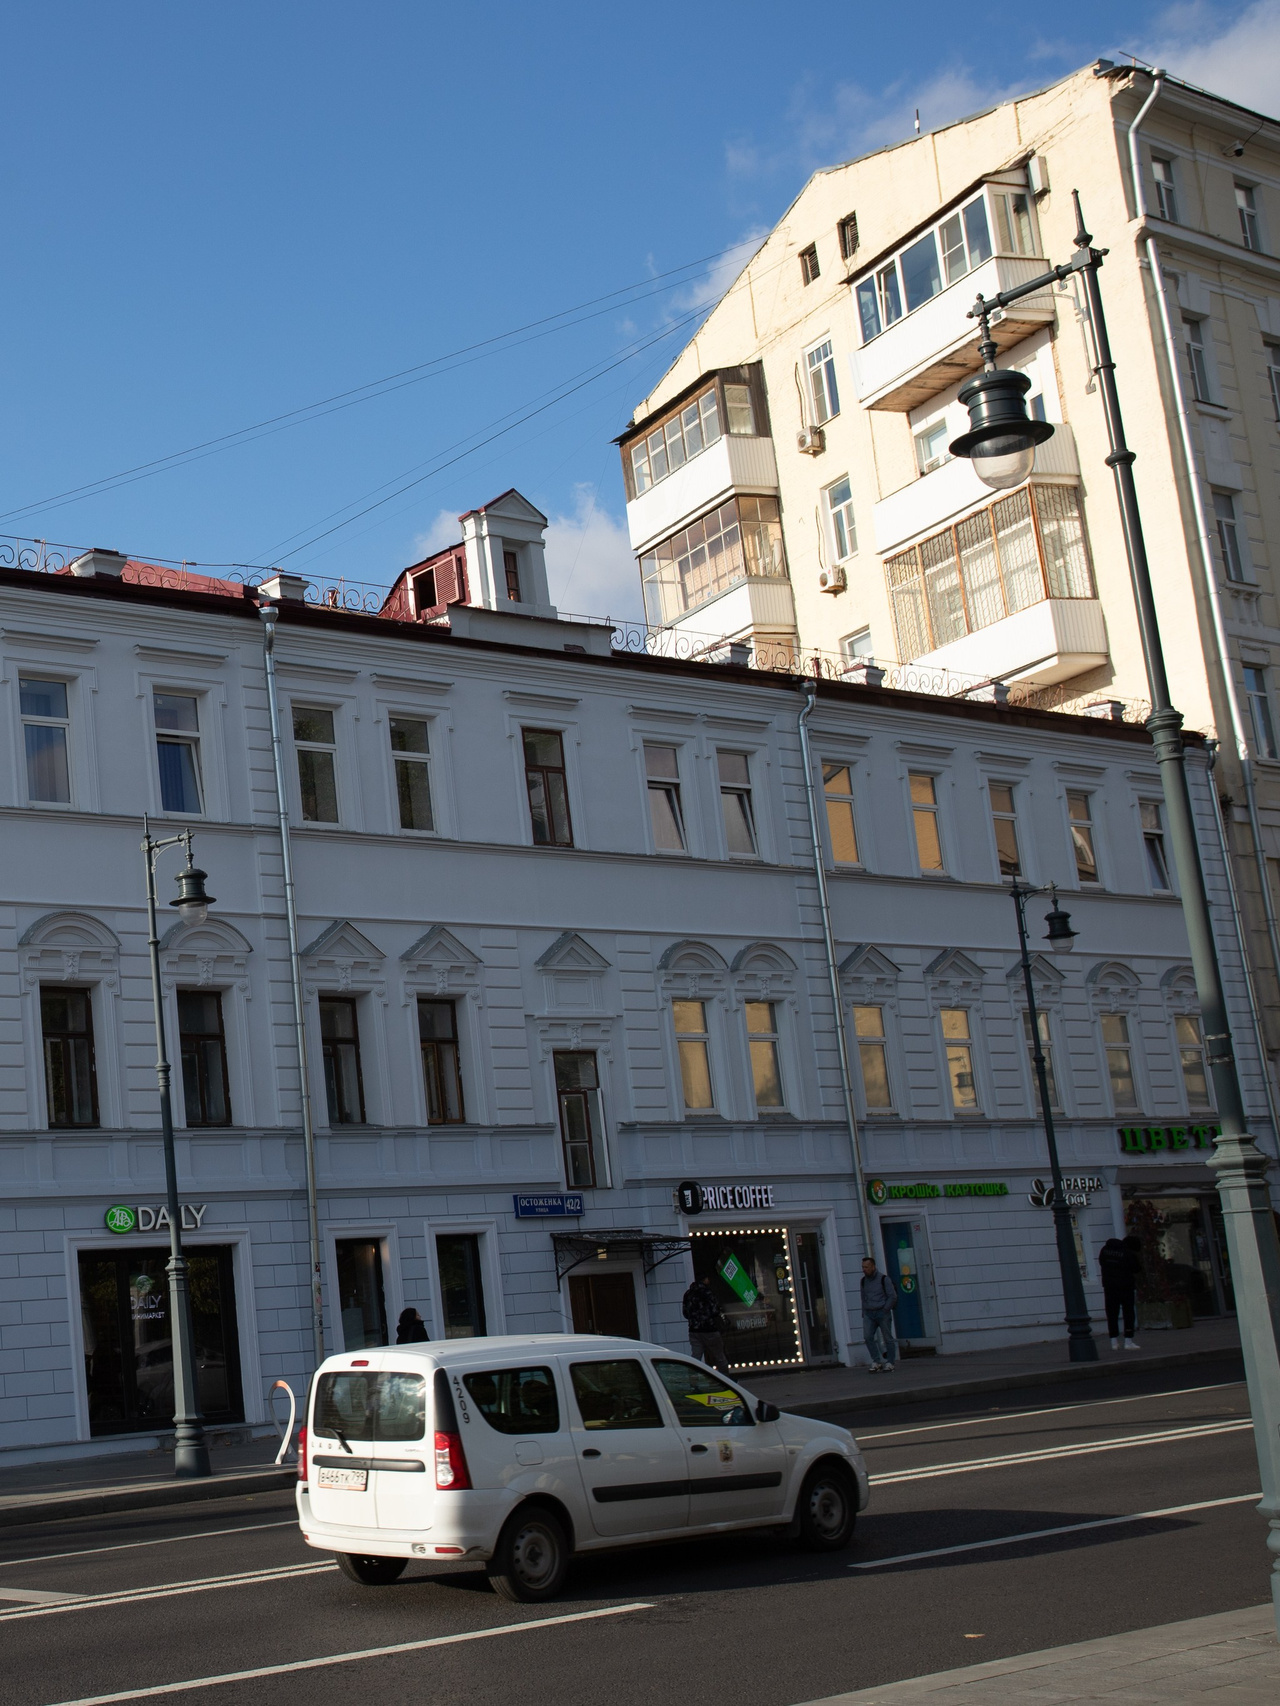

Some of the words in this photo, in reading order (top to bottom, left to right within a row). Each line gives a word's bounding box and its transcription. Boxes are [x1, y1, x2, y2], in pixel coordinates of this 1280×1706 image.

[1119, 1126, 1223, 1154] ЦВЕТ
[889, 1185, 940, 1199] КРОШКА
[943, 1183, 1009, 1197] КАРТОШКА
[1063, 1193, 1091, 1207] ОФЕ
[520, 1198, 562, 1207] ОСТОЖЕНКА
[566, 1199, 581, 1211] 42/2
[137, 1204, 207, 1231] DALY
[453, 1376, 471, 1424] 4209
